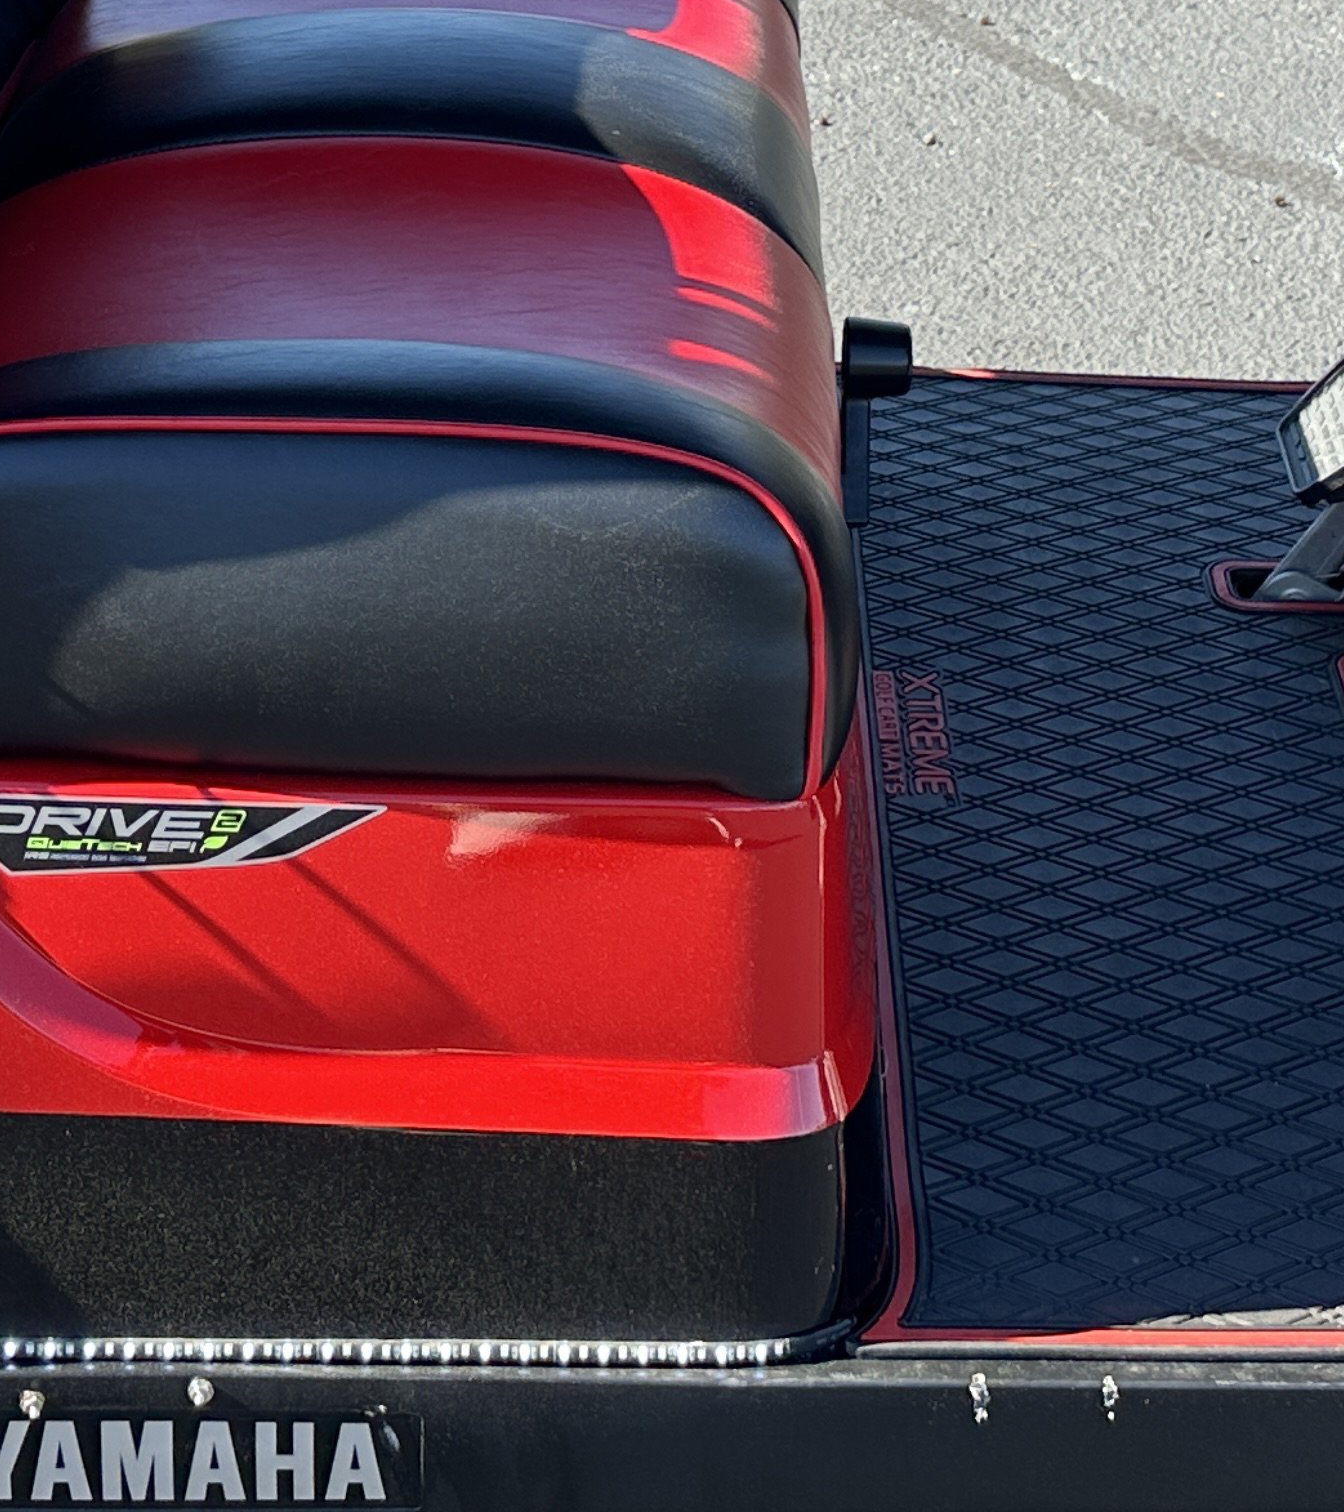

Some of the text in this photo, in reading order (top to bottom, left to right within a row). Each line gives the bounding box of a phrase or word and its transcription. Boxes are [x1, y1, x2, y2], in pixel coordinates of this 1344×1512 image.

[874, 673, 906, 795] GOLF CART MATS
[901, 671, 956, 795] XTREME
